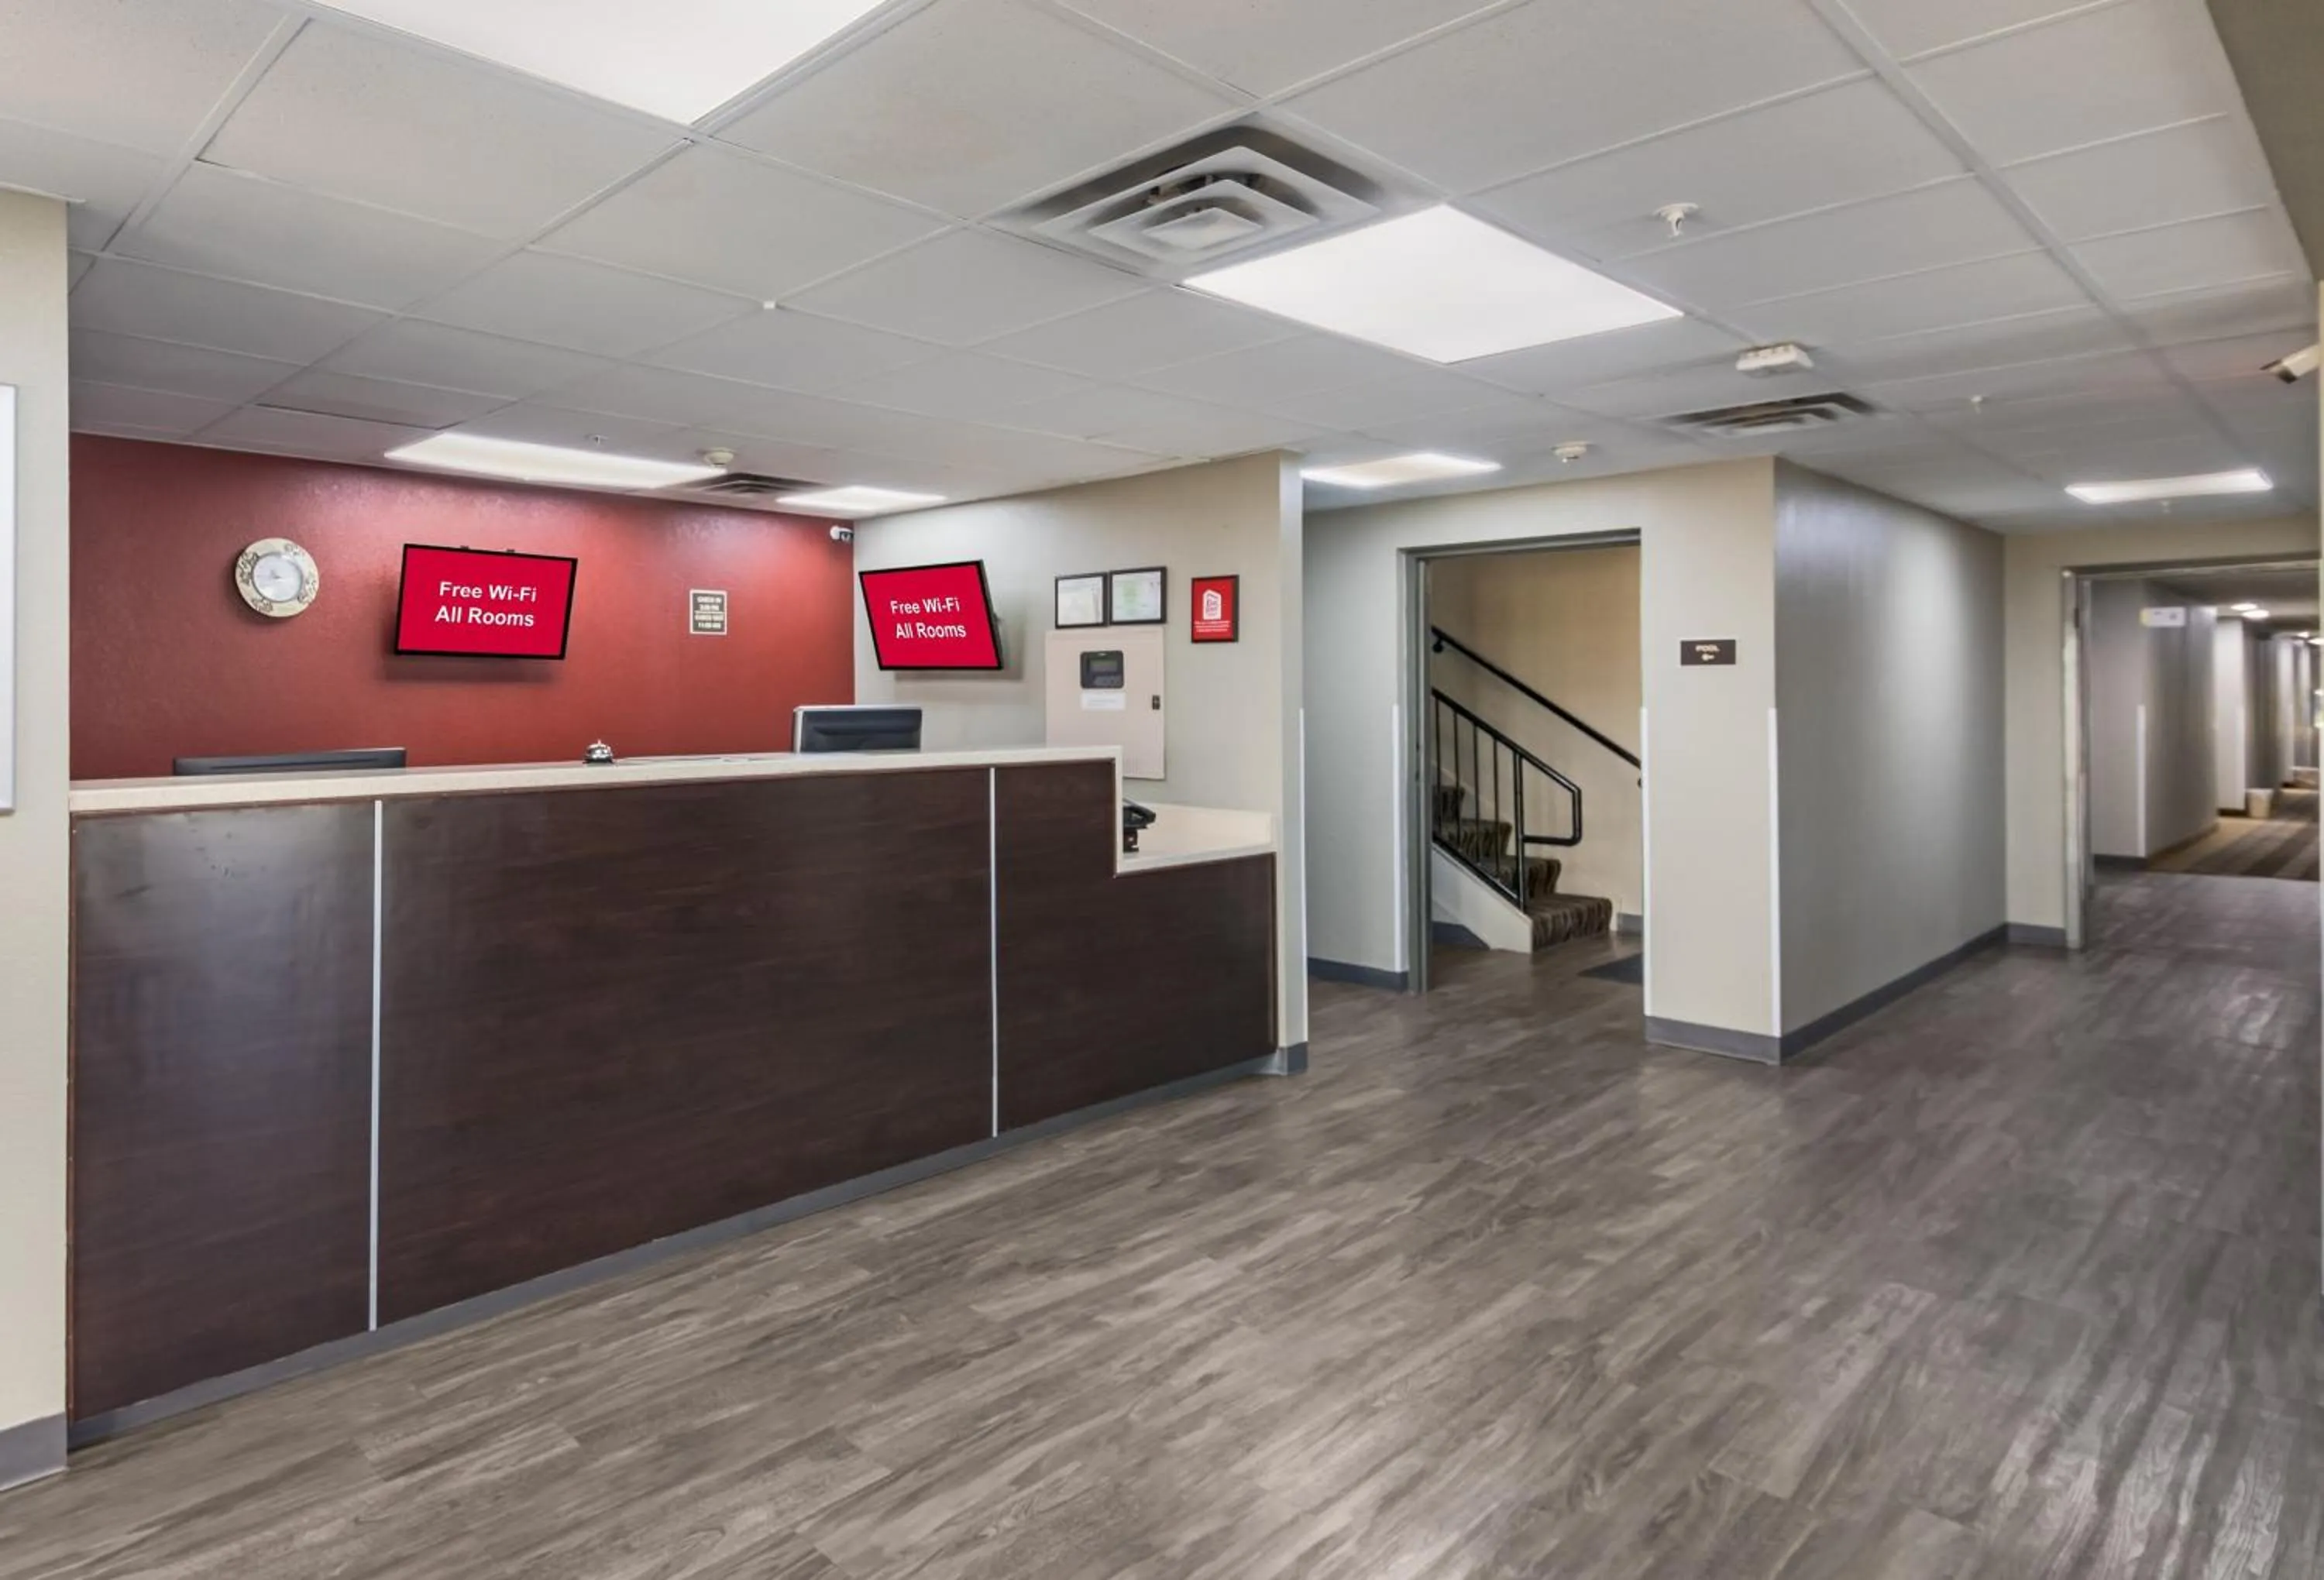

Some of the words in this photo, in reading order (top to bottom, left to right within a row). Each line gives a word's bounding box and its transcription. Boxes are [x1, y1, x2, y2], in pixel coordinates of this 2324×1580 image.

[439, 582, 483, 599] Free
[490, 584, 537, 603] Wi-Fi
[890, 600, 920, 614] Free
[923, 597, 960, 613] Wi-Fi
[435, 606, 462, 623] All
[468, 607, 535, 627] Rooms
[896, 622, 913, 639] All
[916, 622, 967, 639] Rooms
